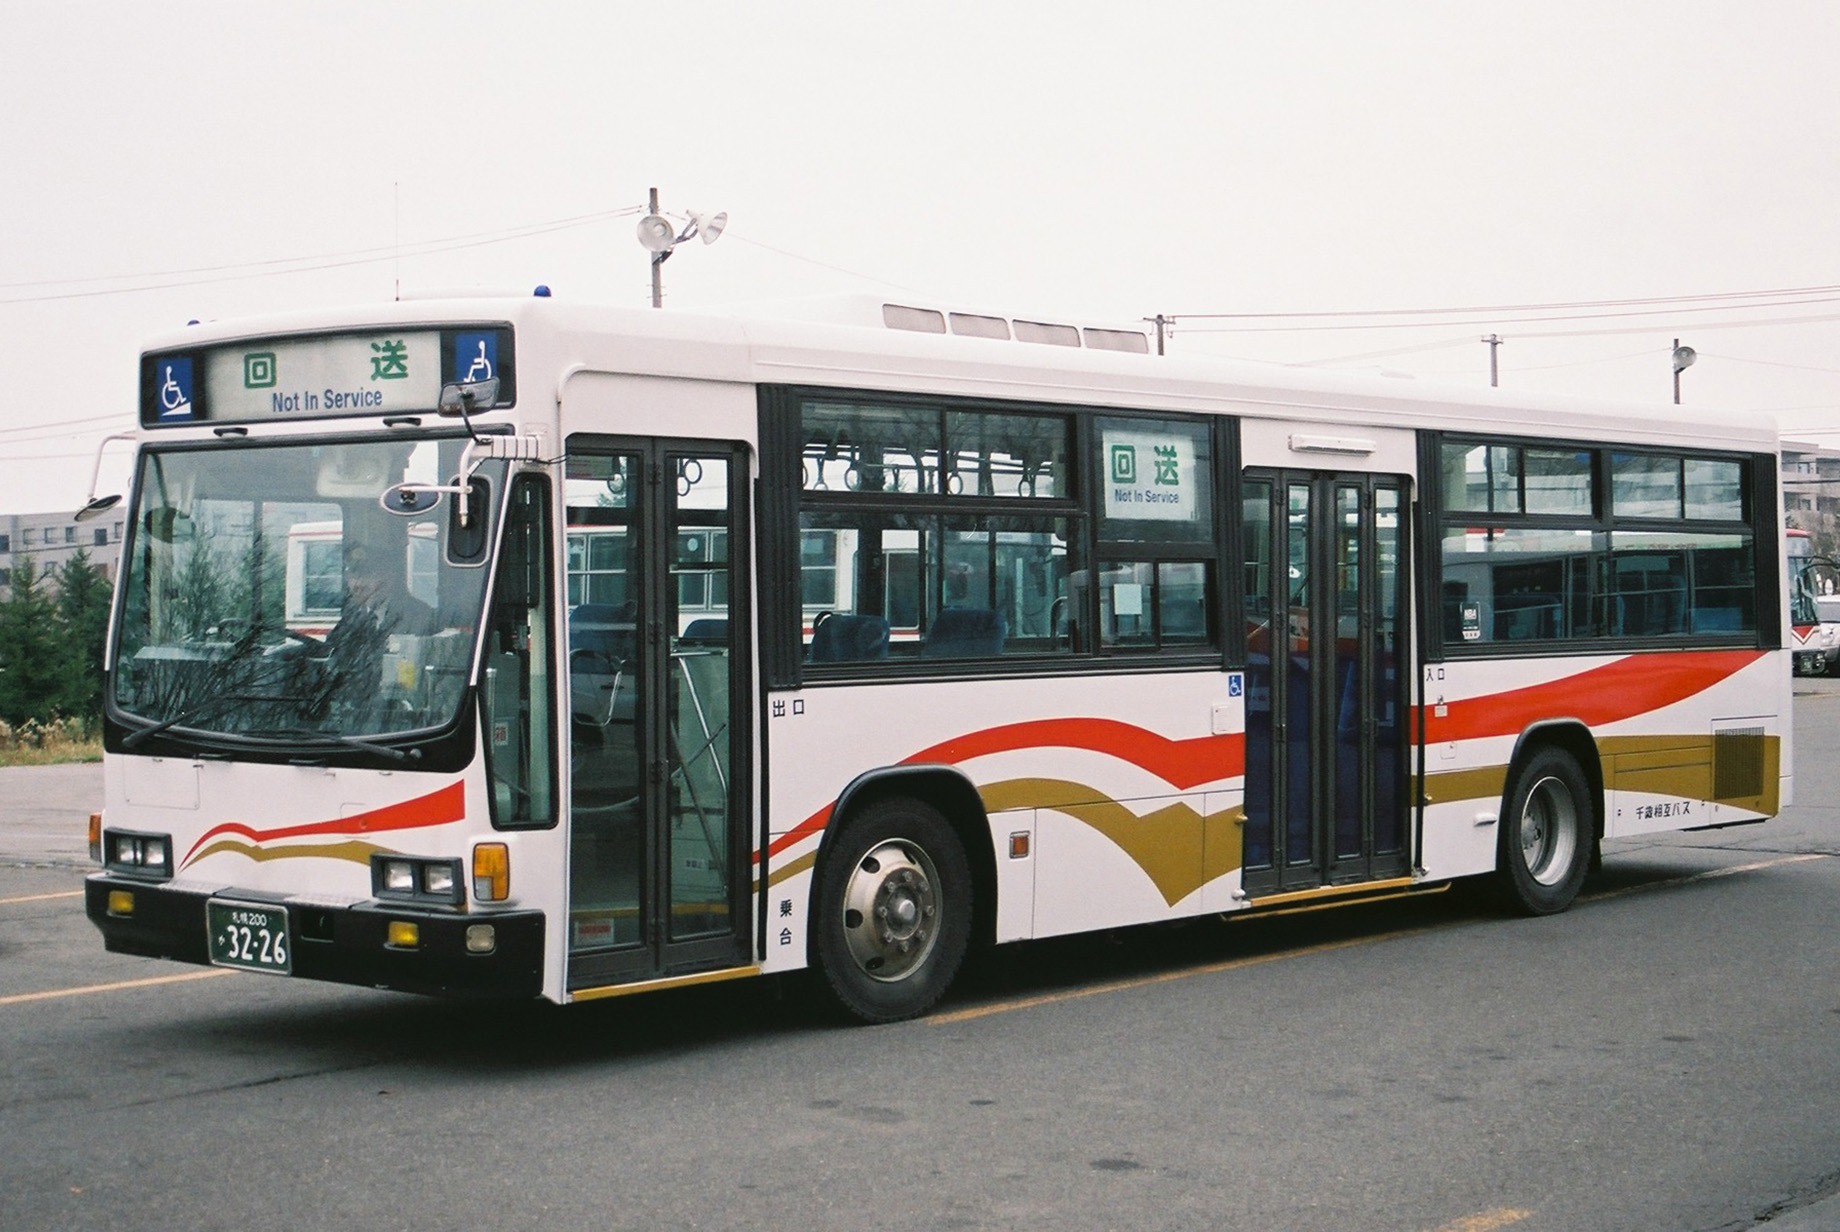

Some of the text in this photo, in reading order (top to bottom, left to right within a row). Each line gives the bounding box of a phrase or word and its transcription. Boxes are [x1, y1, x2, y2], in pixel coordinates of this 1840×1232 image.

[272, 387, 383, 413] Not In Service
[1114, 489, 1180, 504] Not In Service
[1425, 667, 1446, 682] 入口
[772, 698, 805, 718] 出口
[1636, 801, 1691, 820] 千歳相互バス
[779, 898, 793, 946] 乗合
